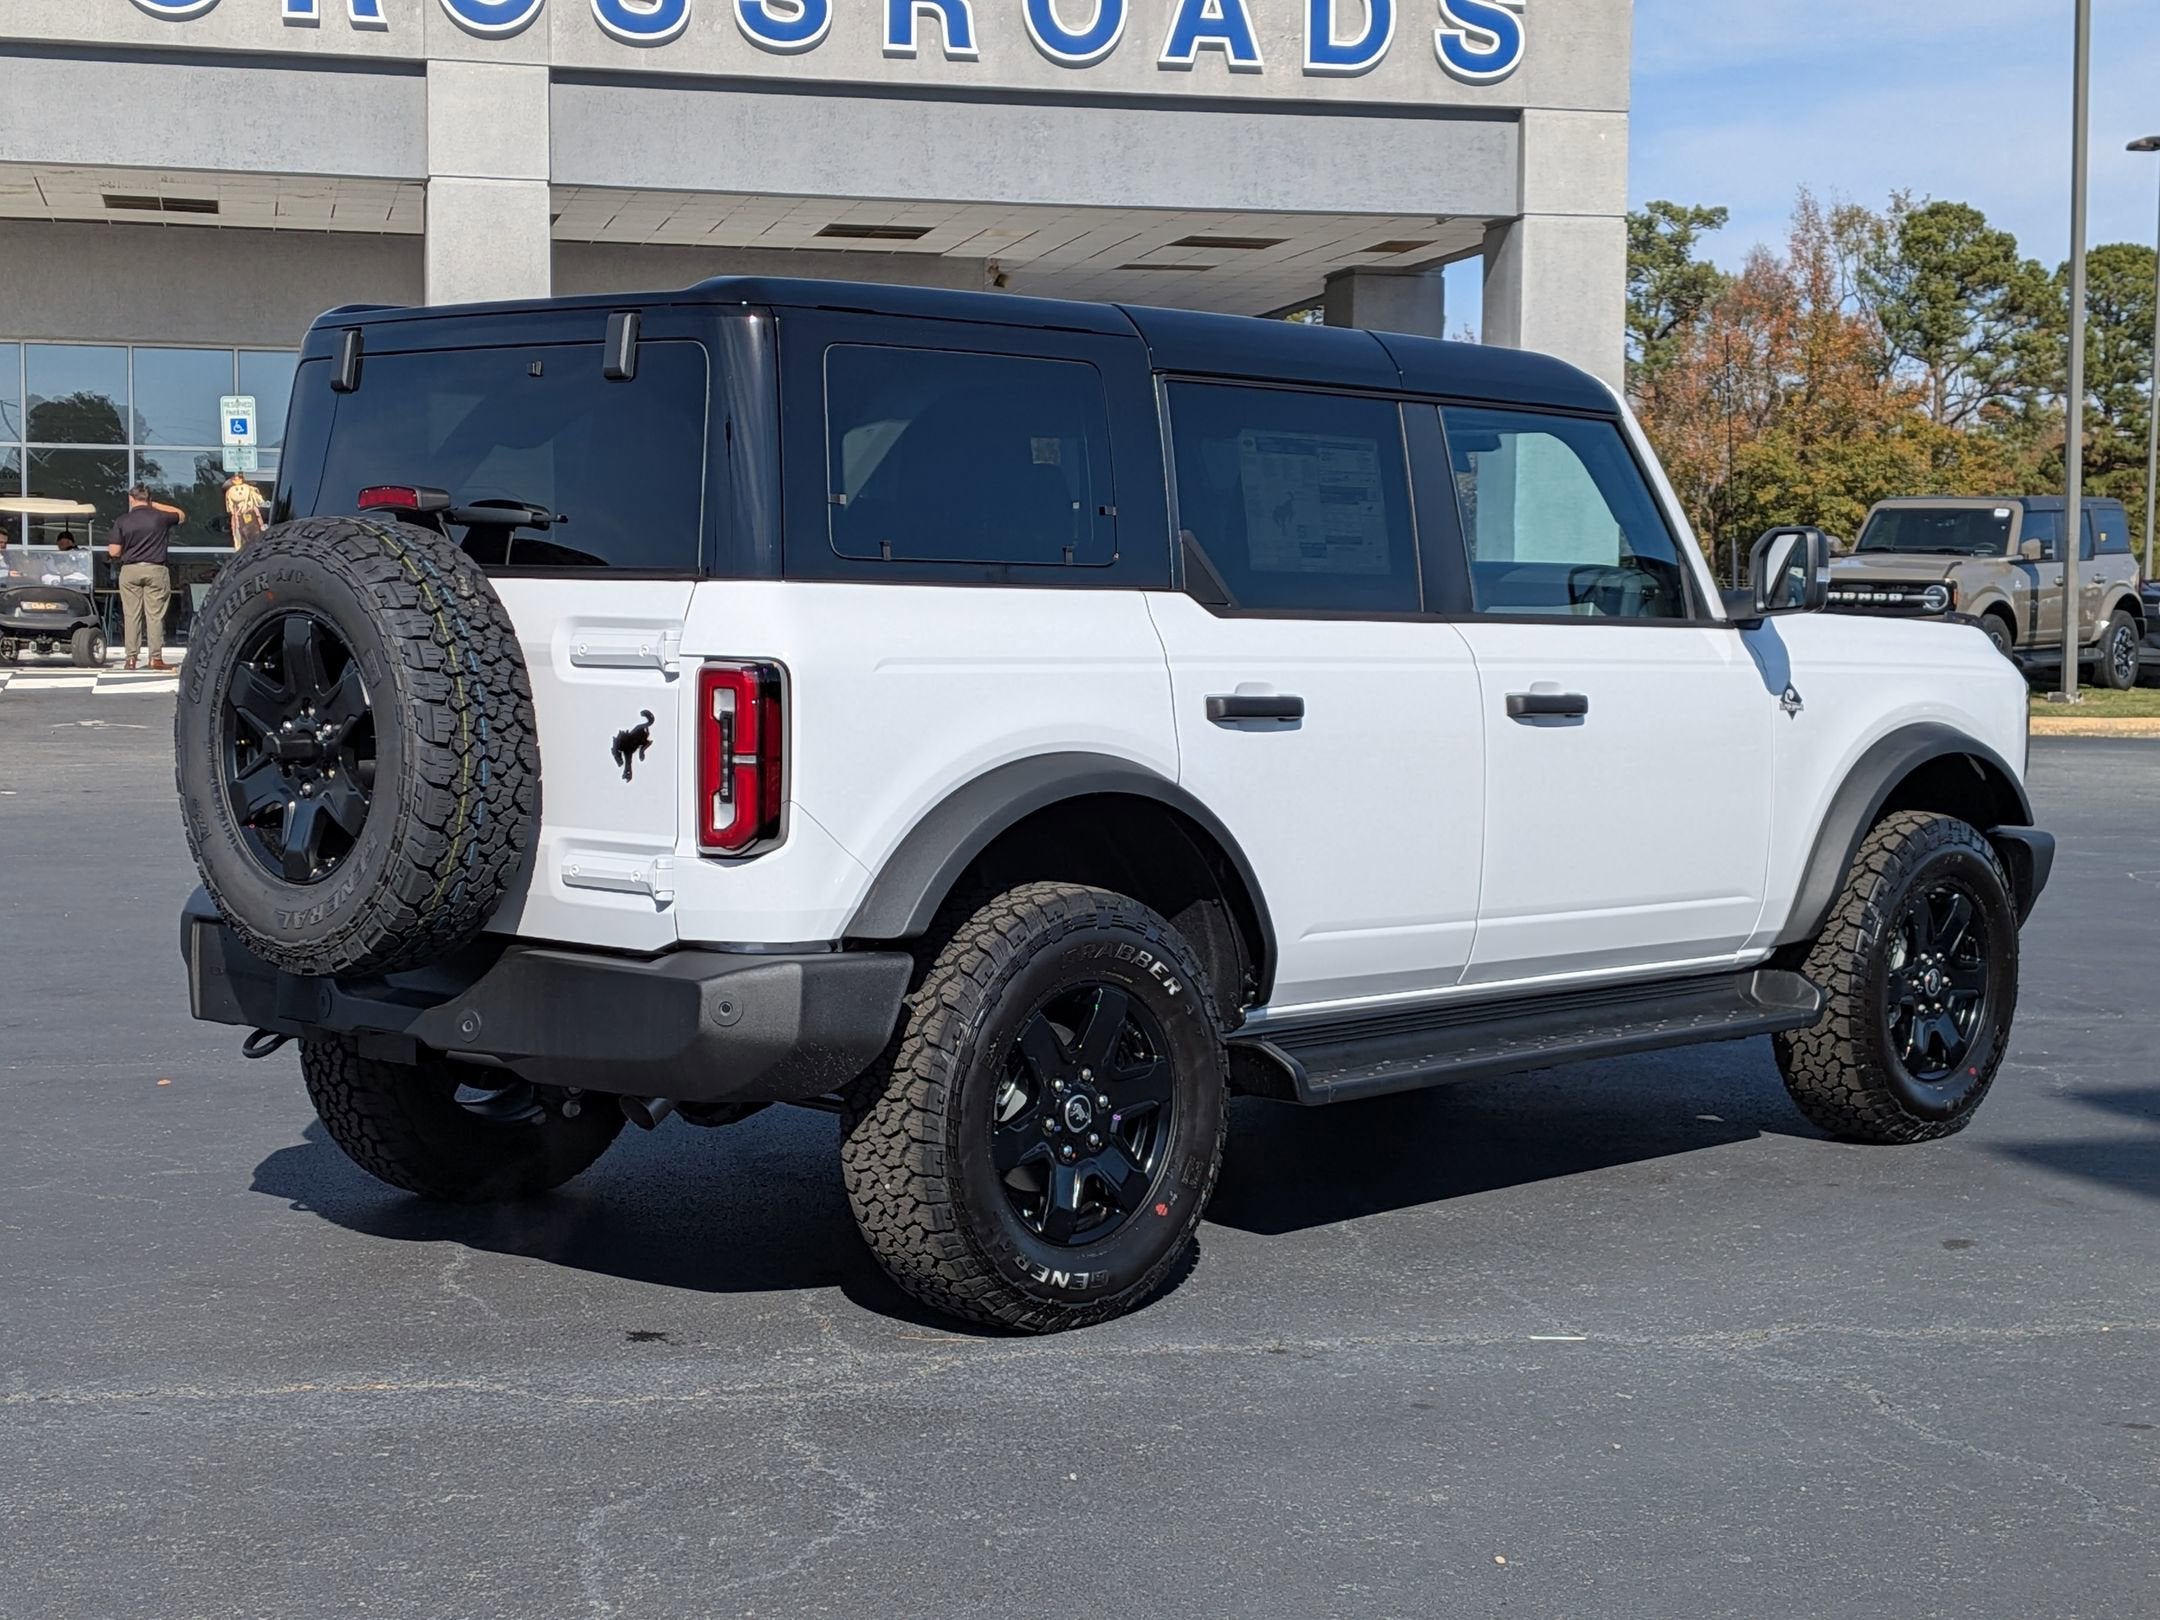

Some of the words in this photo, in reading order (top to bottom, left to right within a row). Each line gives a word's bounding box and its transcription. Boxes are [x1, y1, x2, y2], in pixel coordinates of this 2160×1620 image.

[189, 571, 270, 704] GRABBER
[275, 832, 377, 929] GENERAL
[1062, 942, 1183, 996] GRABBER
